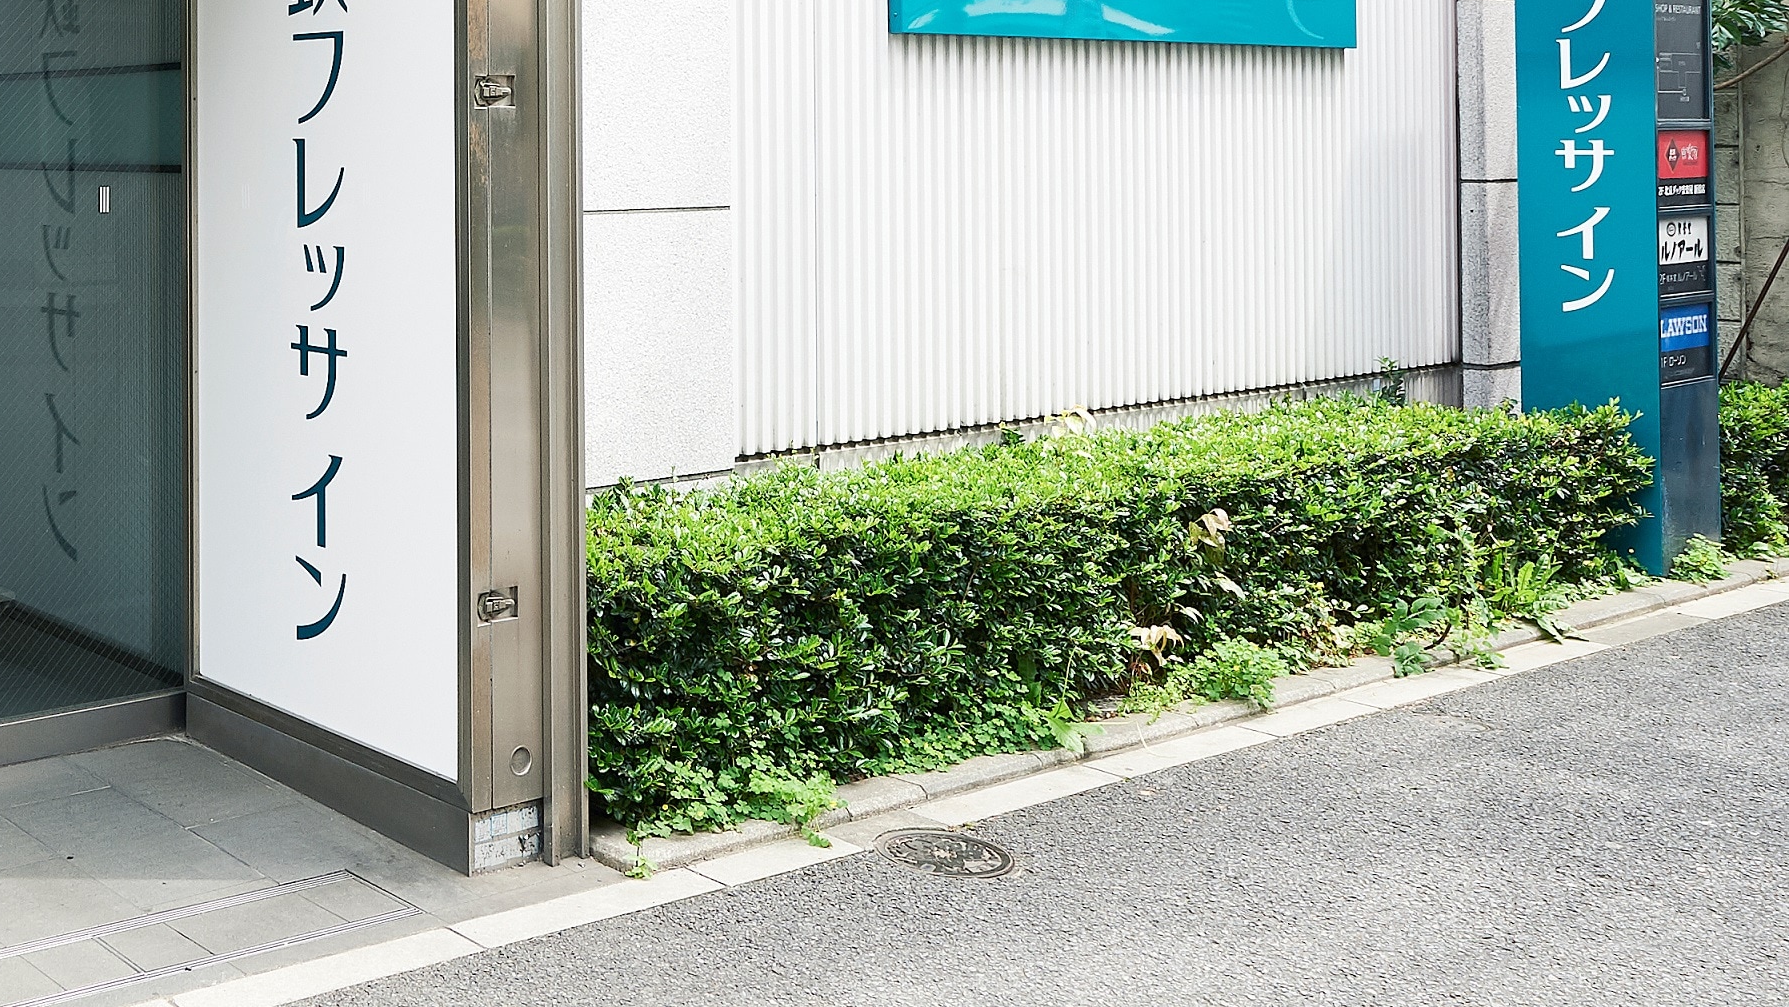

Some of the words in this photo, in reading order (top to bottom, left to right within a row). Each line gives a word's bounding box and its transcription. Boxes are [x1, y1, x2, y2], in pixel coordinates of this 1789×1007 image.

[1673, 4, 1701, 15] RESTAURANT
[1661, 238, 1703, 261] ルノアール
[1660, 314, 1708, 338] LAWSON
